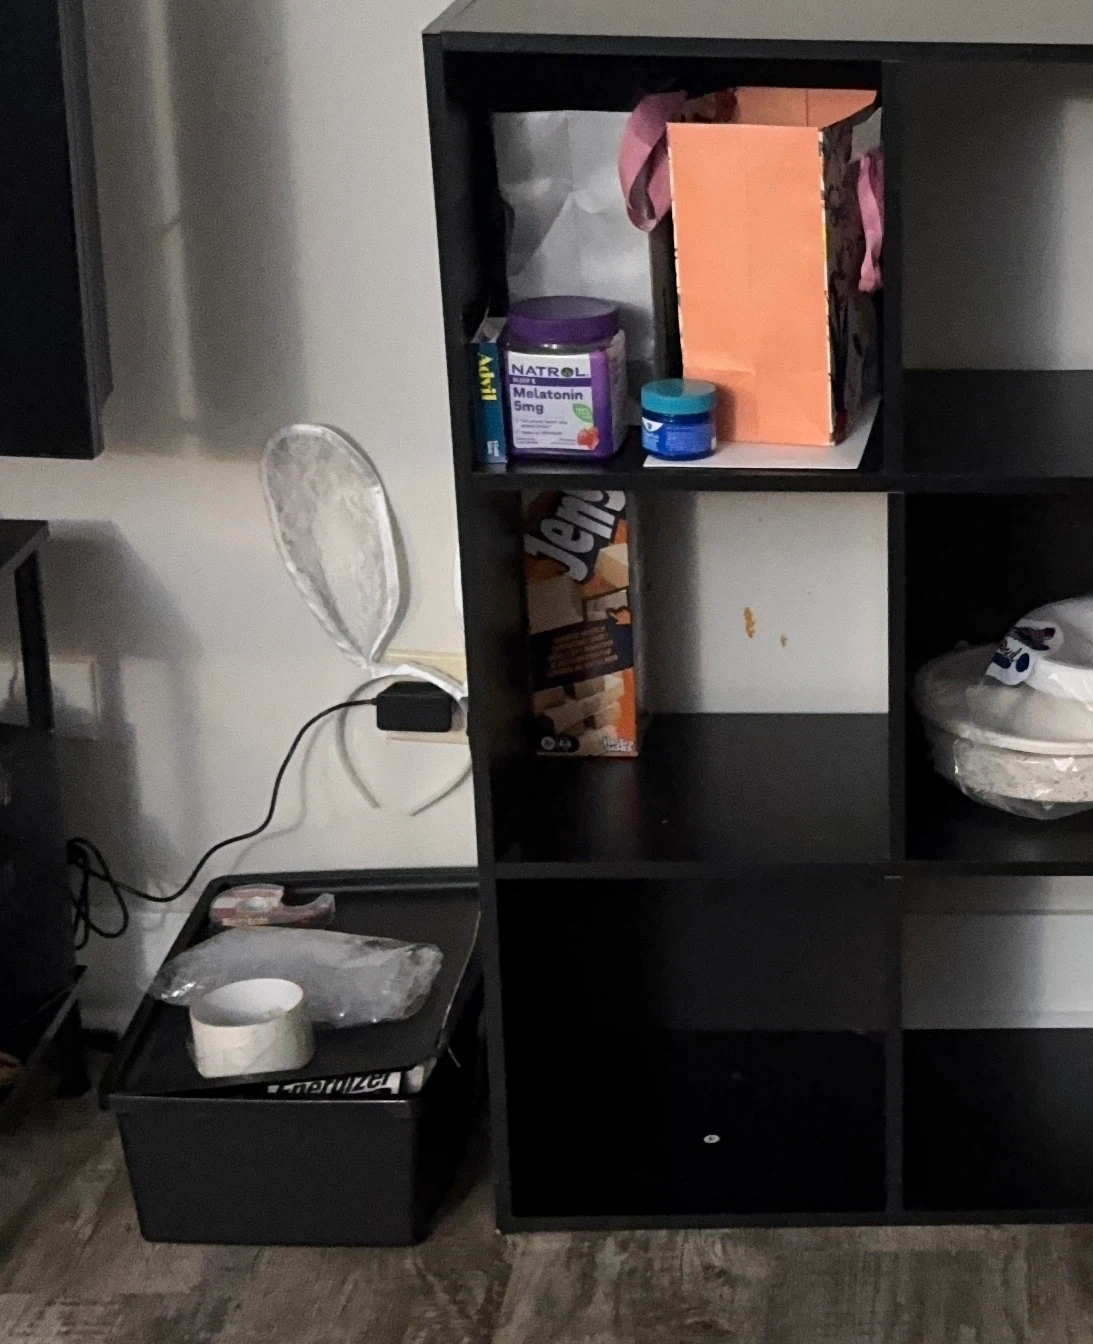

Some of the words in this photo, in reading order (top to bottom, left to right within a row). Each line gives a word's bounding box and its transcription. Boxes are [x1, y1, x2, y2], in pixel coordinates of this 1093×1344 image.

[477, 352, 498, 401] Advil
[511, 364, 586, 377] NATROL
[513, 387, 584, 400] Melatonin
[514, 400, 544, 415] 5mg
